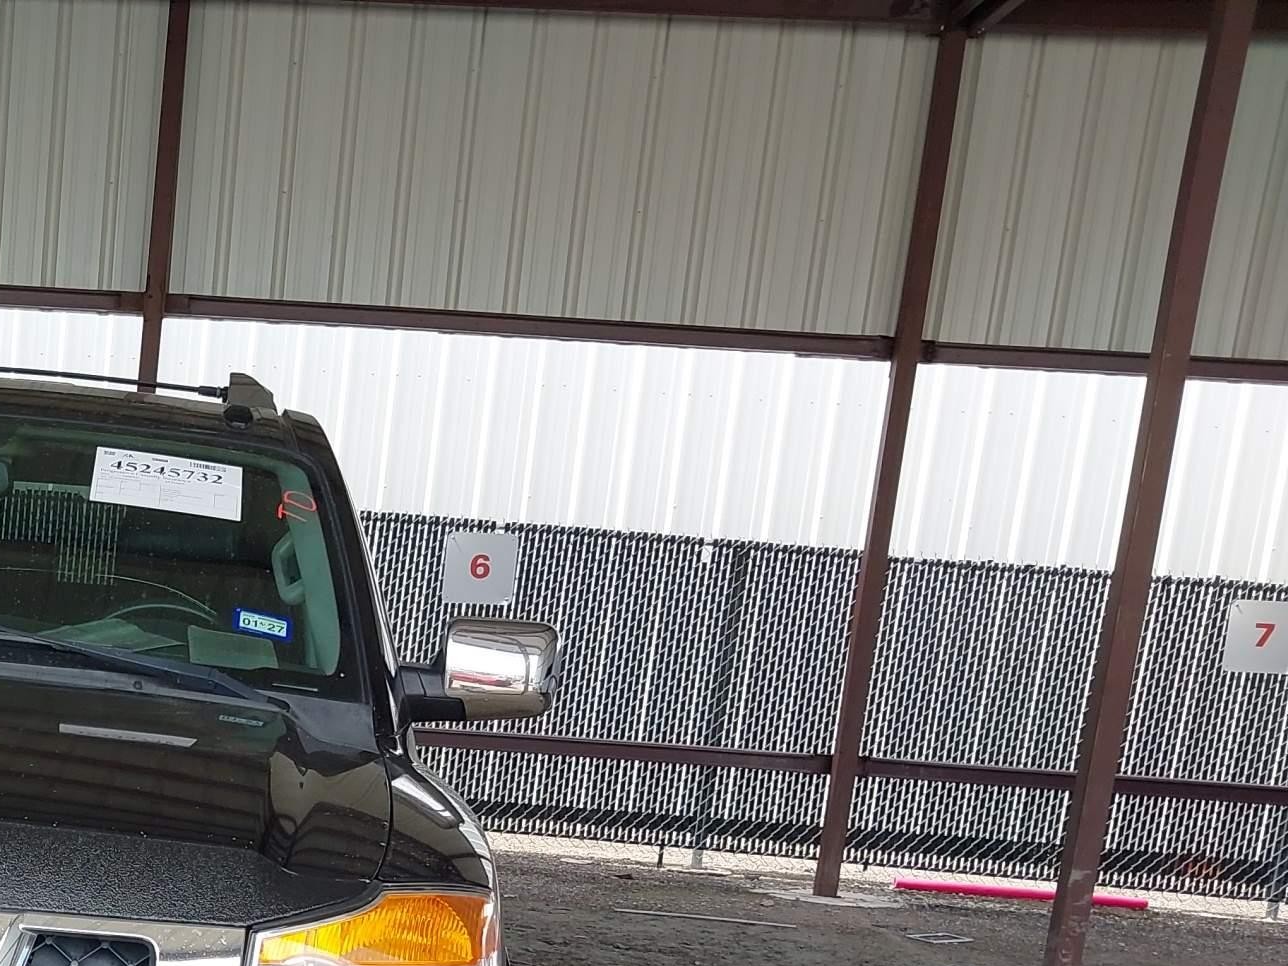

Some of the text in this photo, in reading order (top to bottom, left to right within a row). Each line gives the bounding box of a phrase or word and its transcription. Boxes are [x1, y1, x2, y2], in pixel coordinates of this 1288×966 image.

[110, 460, 224, 485] 45245732
[469, 554, 489, 579] 6
[242, 617, 258, 628] 01
[267, 623, 285, 633] 27
[1255, 622, 1276, 648] 7
